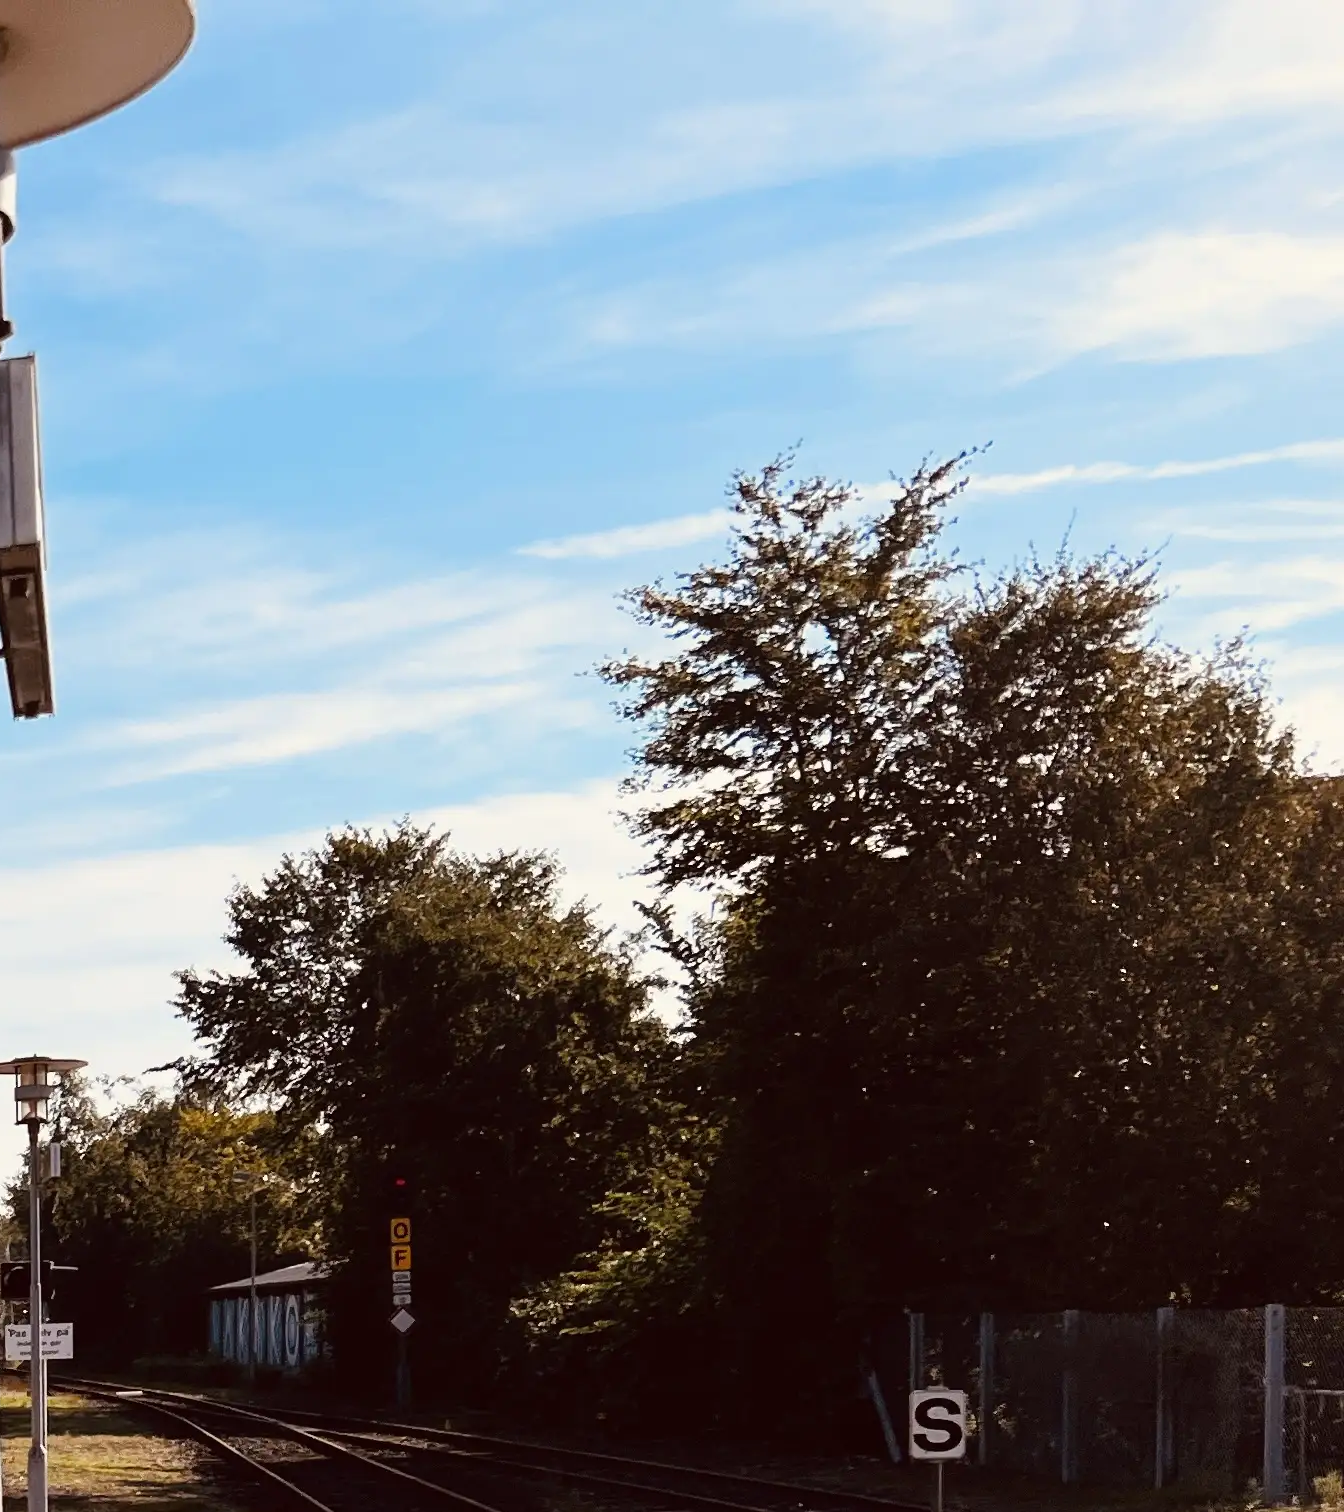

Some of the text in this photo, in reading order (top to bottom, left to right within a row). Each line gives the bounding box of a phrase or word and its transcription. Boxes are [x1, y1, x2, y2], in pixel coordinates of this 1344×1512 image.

[393, 1222, 408, 1238] O
[394, 1249, 408, 1266] F
[913, 1398, 963, 1452] S
